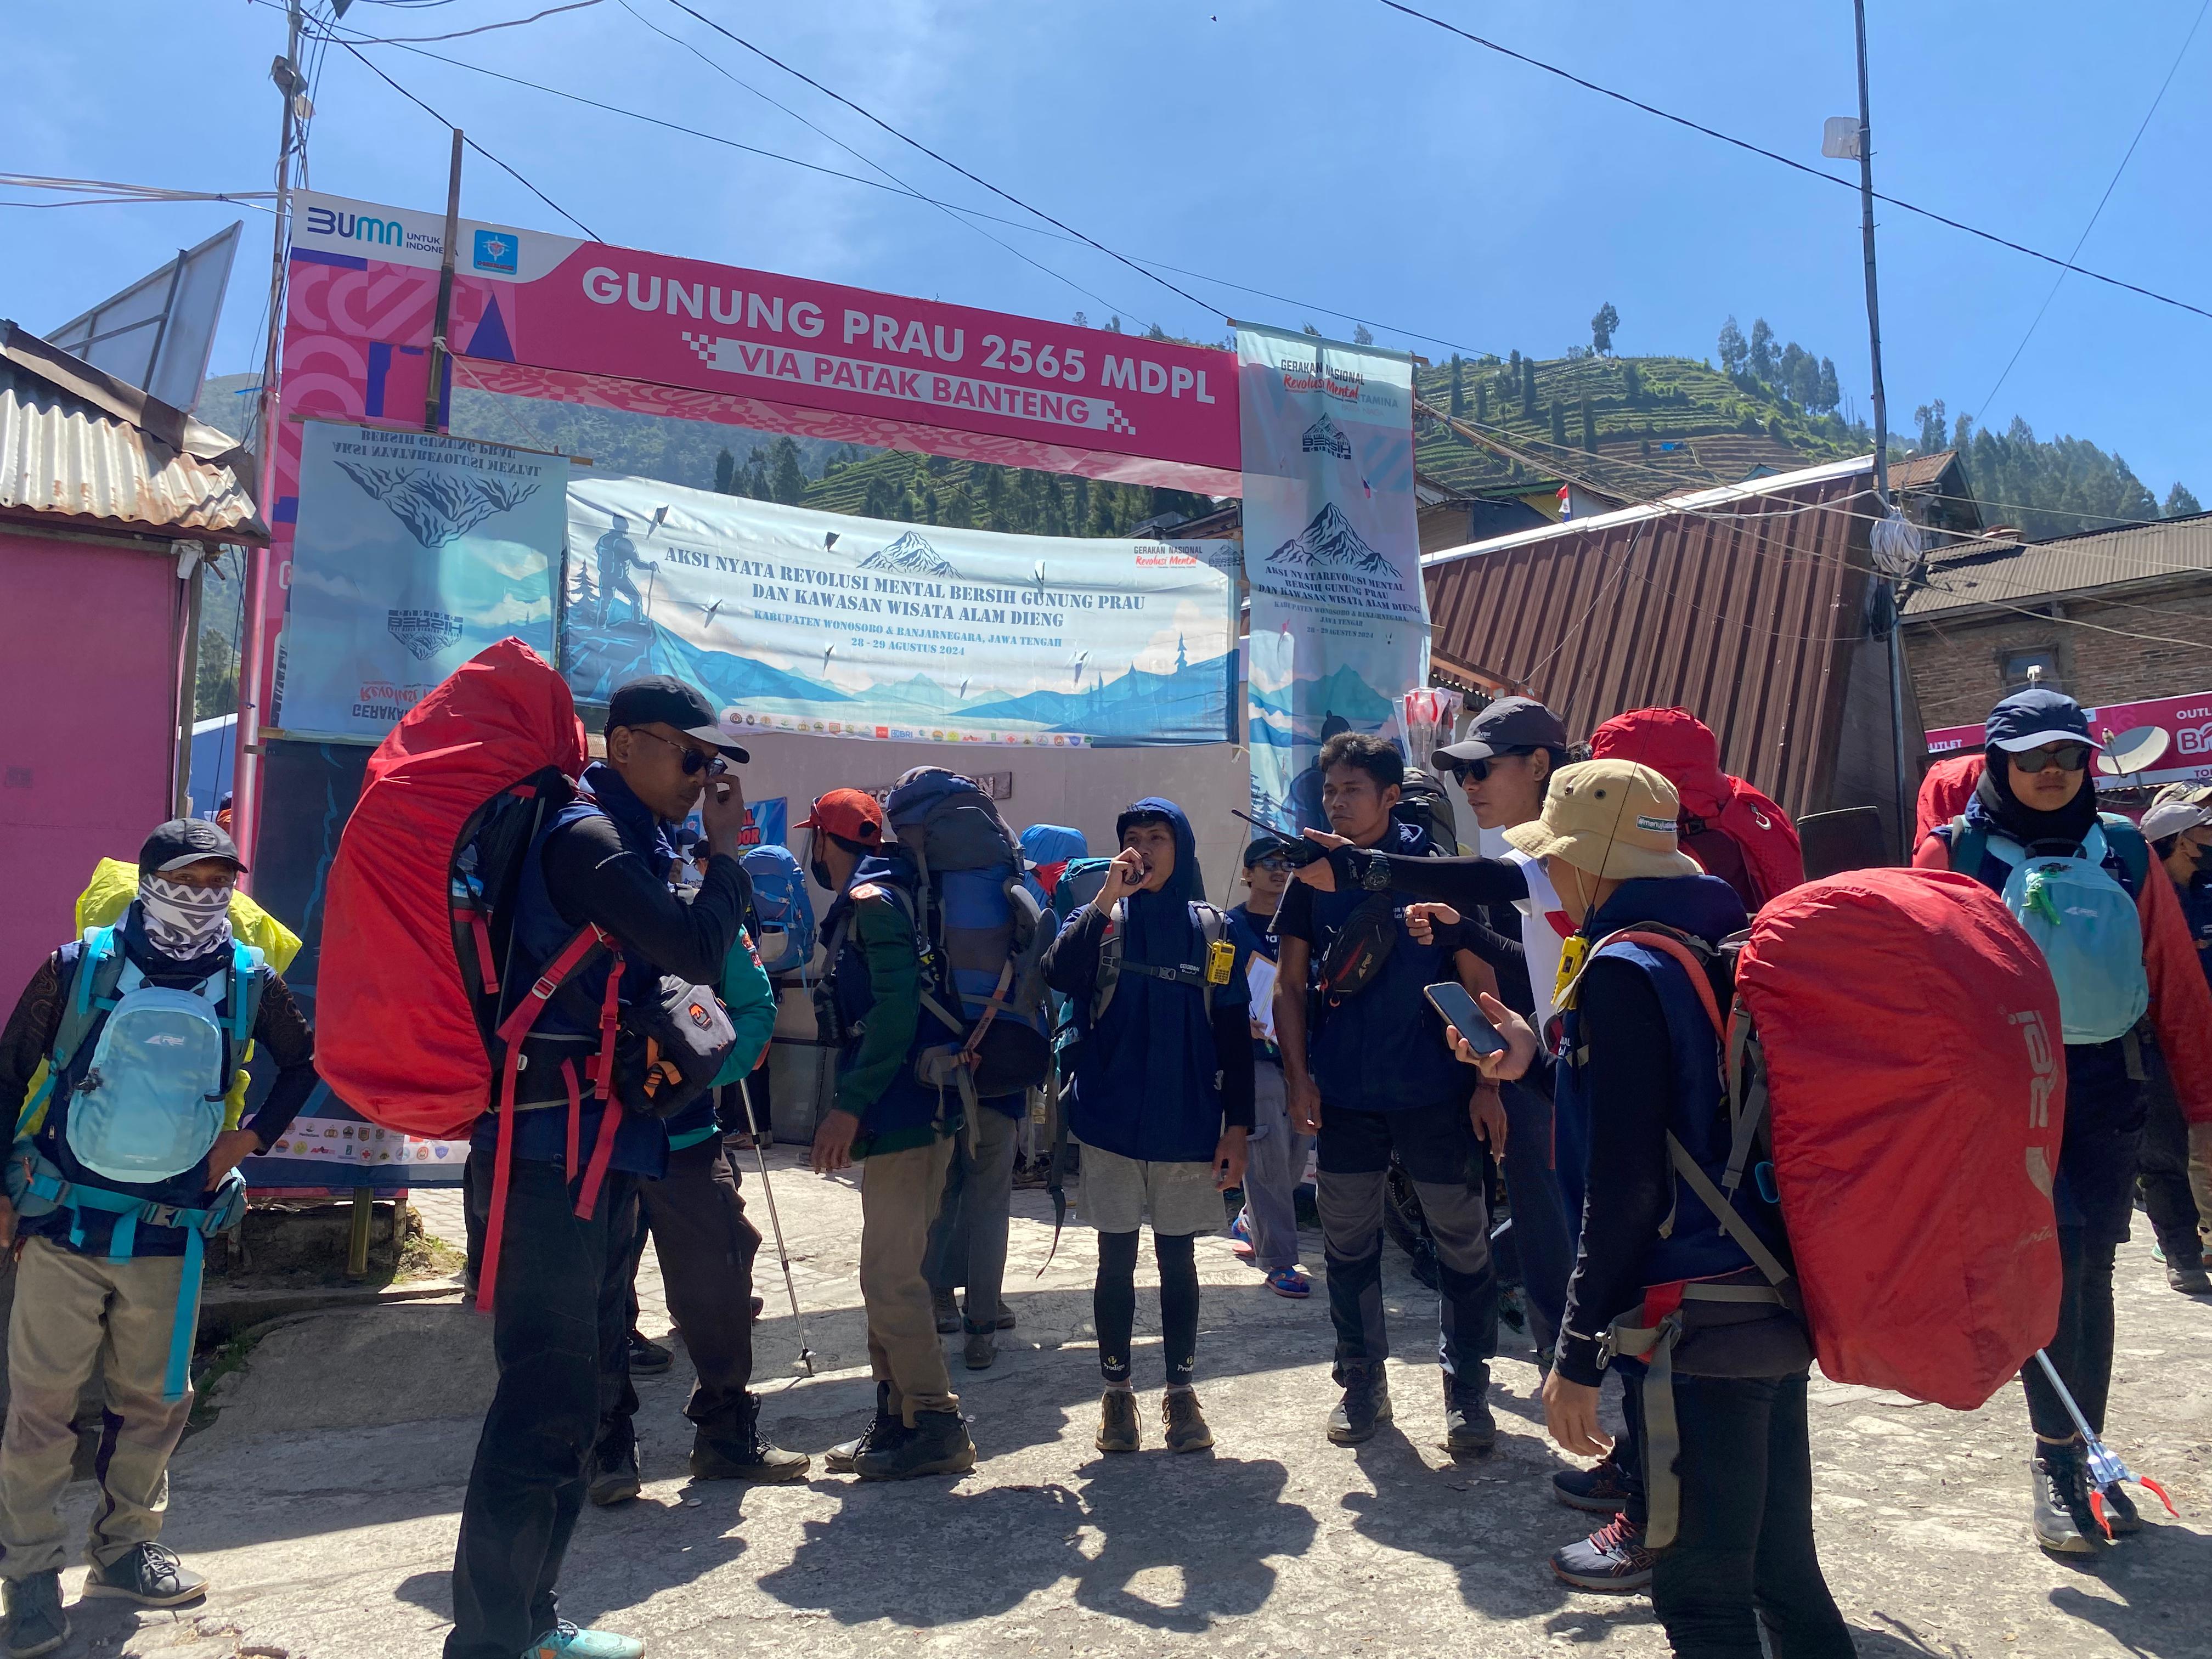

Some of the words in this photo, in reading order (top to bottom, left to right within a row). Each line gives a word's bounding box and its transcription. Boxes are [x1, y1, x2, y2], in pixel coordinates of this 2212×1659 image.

[407, 232, 441, 245] UNTUK
[406, 242, 459, 257] INDONEA
[582, 266, 825, 338] GUNUNG
[843, 309, 964, 362] PRAU
[981, 335, 1086, 382] 2565
[1101, 354, 1215, 404] MDPL
[1281, 359, 1323, 373] GERAKAN
[1325, 364, 1364, 385] NASIONAL
[738, 345, 802, 380] VIA
[814, 357, 921, 398] PATAK
[933, 377, 1090, 424] BANTENG
[1284, 374, 1324, 390] Revolusi
[1327, 379, 1359, 399] Mental
[1303, 438, 1351, 454] BERSIH
[1134, 546, 1165, 554] GERAKAN
[1169, 546, 1203, 554] NASIONAL
[1136, 555, 1167, 565] Revolusi
[1169, 554, 1198, 566] Mental
[664, 547, 710, 569] AKSI
[715, 556, 775, 579] NYATA
[780, 565, 869, 591] REVOLUSI
[874, 577, 945, 599] MENTAL
[949, 585, 1015, 605] BERSIH
[1021, 591, 1093, 609] GUNUNG
[1098, 595, 1146, 610] PRAU
[1266, 566, 1288, 577] AKSI
[1368, 579, 1405, 591] MENTAL
[1259, 584, 1277, 594] DAN
[1280, 587, 1326, 602] KAWASAN
[1328, 594, 1363, 606] WISATA
[1365, 599, 1390, 610] ALAM
[1392, 602, 1420, 614] DIENG
[1285, 579, 1322, 592] BERSIH
[1325, 583, 1362, 596] GUNUNG
[1364, 588, 1389, 599] PRAU
[752, 583, 789, 602] DAN
[794, 589, 882, 613] KAWASAN
[888, 600, 953, 620] WISATA
[958, 606, 1006, 624] ALAM
[1009, 610, 1064, 628] DIENG
[1274, 601, 1313, 612] KABUPATEN
[754, 610, 821, 627] KABUPATEN
[823, 619, 883, 635] WONOSOBO
[885, 625, 894, 635] &
[896, 627, 986, 644] BANJARNEGARA,
[988, 634, 1017, 645] JAWA
[1020, 636, 1062, 648] TENGAH
[851, 637, 864, 648] 28
[873, 639, 885, 650] 29
[888, 641, 936, 654] AGUSTUS
[939, 645, 965, 656] 2024
[900, 729, 913, 738] BRI
[1927, 739, 1962, 750] UTLET
